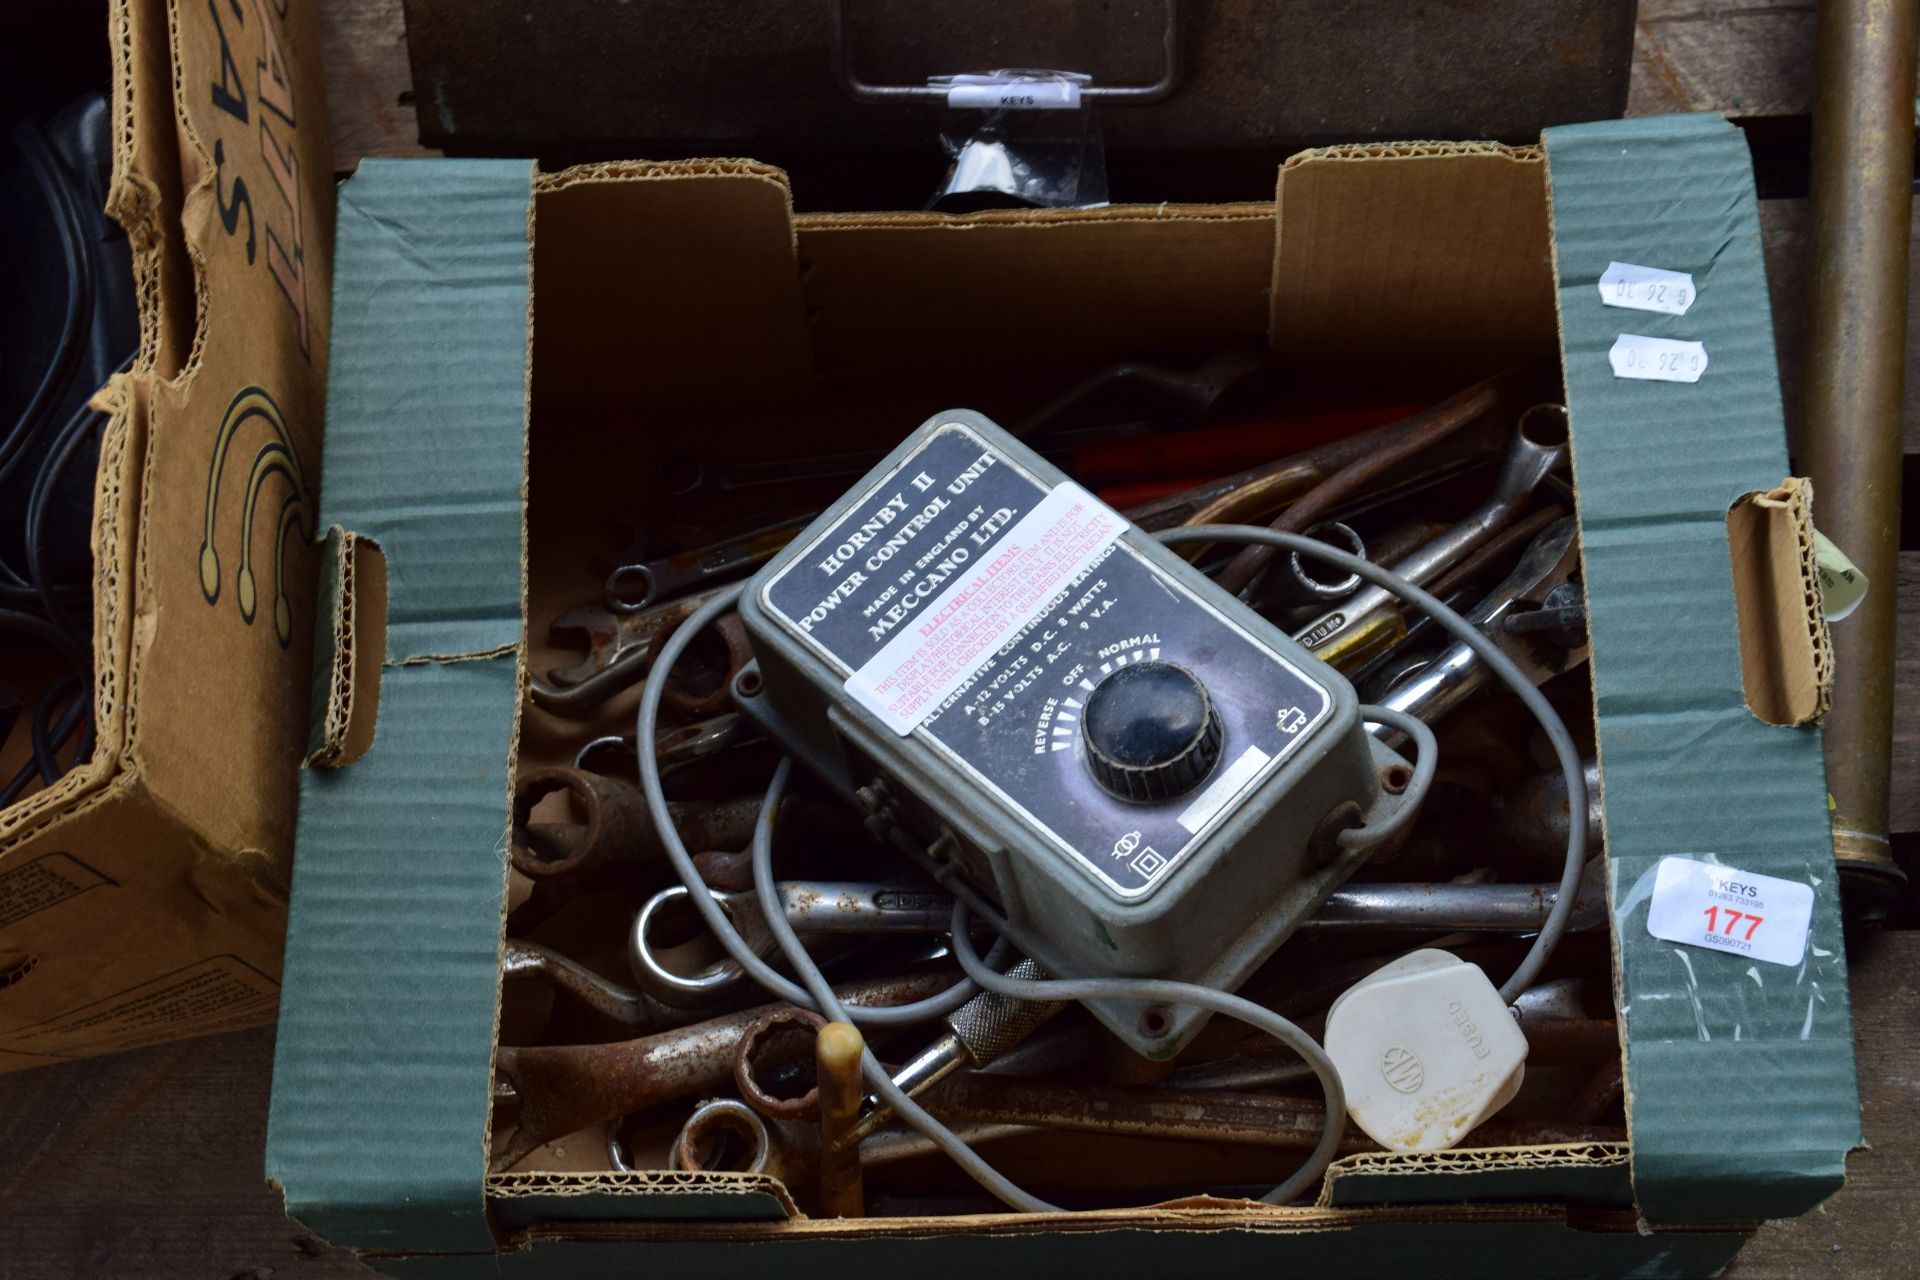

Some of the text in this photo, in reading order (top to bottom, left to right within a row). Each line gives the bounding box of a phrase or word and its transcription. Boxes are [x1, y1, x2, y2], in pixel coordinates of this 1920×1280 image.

[209, 0, 256, 266] AS
[1001, 95, 1034, 105] KEYS
[256, 0, 311, 364] ATT
[798, 450, 996, 634] POWER CONTROL UNIT
[819, 471, 935, 575] HORNBY II
[863, 505, 983, 616] MADE IN ENGLAND BY
[980, 578, 1017, 613] INTEREST
[1043, 543, 1055, 556] IT
[1051, 535, 1064, 548] IS
[1060, 520, 1080, 540] NOT
[869, 508, 1016, 640] MECCANO LTD.
[873, 502, 1084, 694] THIS ITEM IS SOLD AS A COLLECTORS ITEM AND IS FOR
[889, 513, 1104, 713] SUITABLE FOR CONNECTION TO THE MAINS ELECTRICITY
[900, 522, 1112, 719] SUPPLY UNTIL CHECKED BY A QUALIFIED ELECTRICIAN
[919, 544, 1021, 636] ELECTRICAL ITEMS
[923, 542, 1115, 726] ALTERNATIVE CONTINUOUS RATINGS
[964, 579, 1106, 714] A-12 VOLTS D.C. 8 WATTS
[978, 598, 1117, 725] B-15 VOLTS A.C. 9 V.A.
[1062, 663, 1086, 687] OFF
[1097, 632, 1161, 661] NORMAL
[1302, 618, 1340, 647] DIUM
[1034, 697, 1059, 755] REVERSE
[1703, 905, 1764, 941] 177
[1708, 890, 1733, 902] 01263
[1718, 880, 1758, 898] KEYS
[1704, 933, 1752, 950] GS090721
[1449, 1000, 1491, 1060] FUSED
